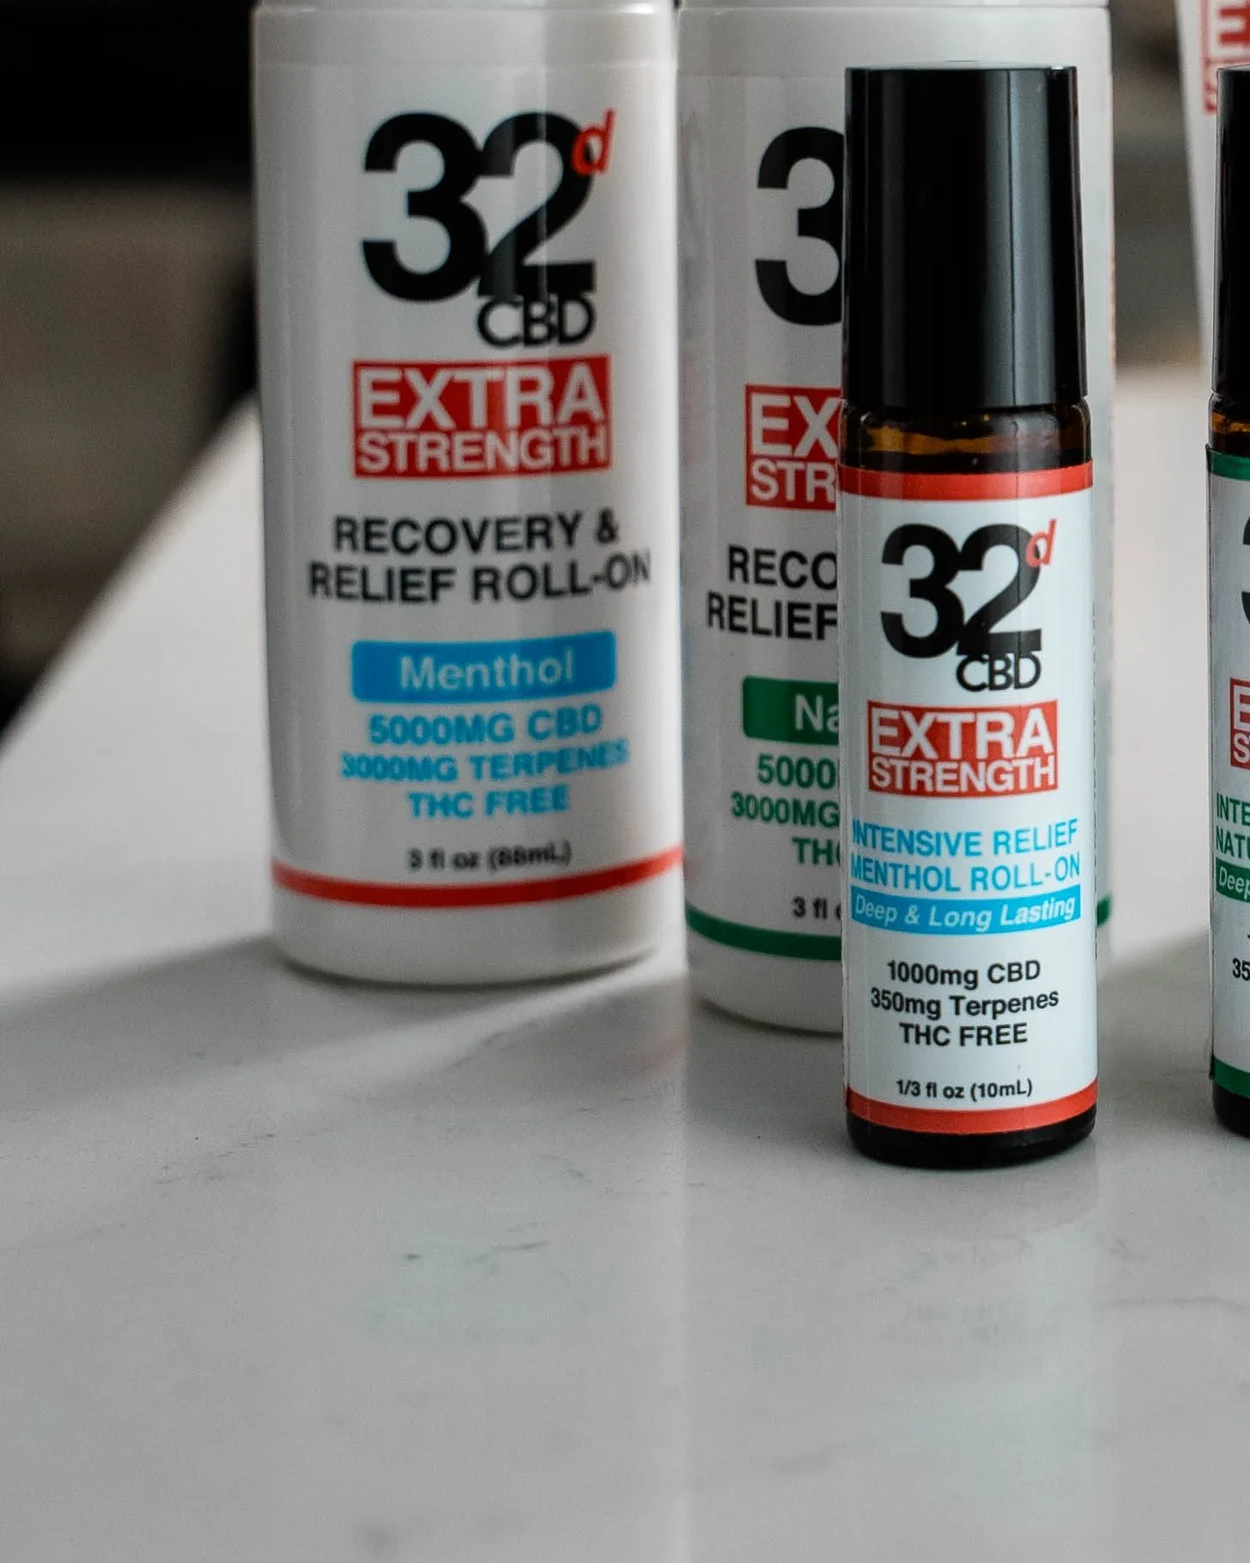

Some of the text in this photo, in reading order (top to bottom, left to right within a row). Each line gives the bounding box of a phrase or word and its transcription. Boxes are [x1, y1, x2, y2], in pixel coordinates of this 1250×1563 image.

[476, 297, 597, 349] CBD
[357, 362, 607, 430] EXTRA
[357, 424, 609, 473] STRENGTH
[333, 507, 620, 557] RECOVERY &
[306, 548, 651, 604] RELIEF ROLL-ON
[400, 649, 575, 690] Menthol
[955, 650, 1042, 692] CBD
[367, 702, 604, 746] 5000MG CBD
[871, 706, 1056, 761] EXTRA
[341, 736, 629, 784] 3000MG TERPENES
[757, 752, 841, 791] 5000
[871, 754, 1056, 794] STRENGTH
[407, 783, 571, 820] THC FREE
[407, 839, 572, 872] 3 fl oz (88mL)
[852, 817, 1078, 857] INTENSIVE RELIEF
[851, 851, 1081, 892] MENTHOL ROLL-ON
[791, 896, 806, 919] 3
[812, 898, 829, 920] fl
[855, 893, 898, 926] Deep
[904, 904, 920, 926] &
[928, 904, 993, 933] Long
[1000, 895, 1076, 927] Lasting
[886, 959, 1041, 991] 1000mg CBD
[870, 986, 1060, 1021] 350mg Terpenes
[899, 1021, 1028, 1047] THC FREE
[896, 1078, 1034, 1103] 1/3 fl oz (10mL)
